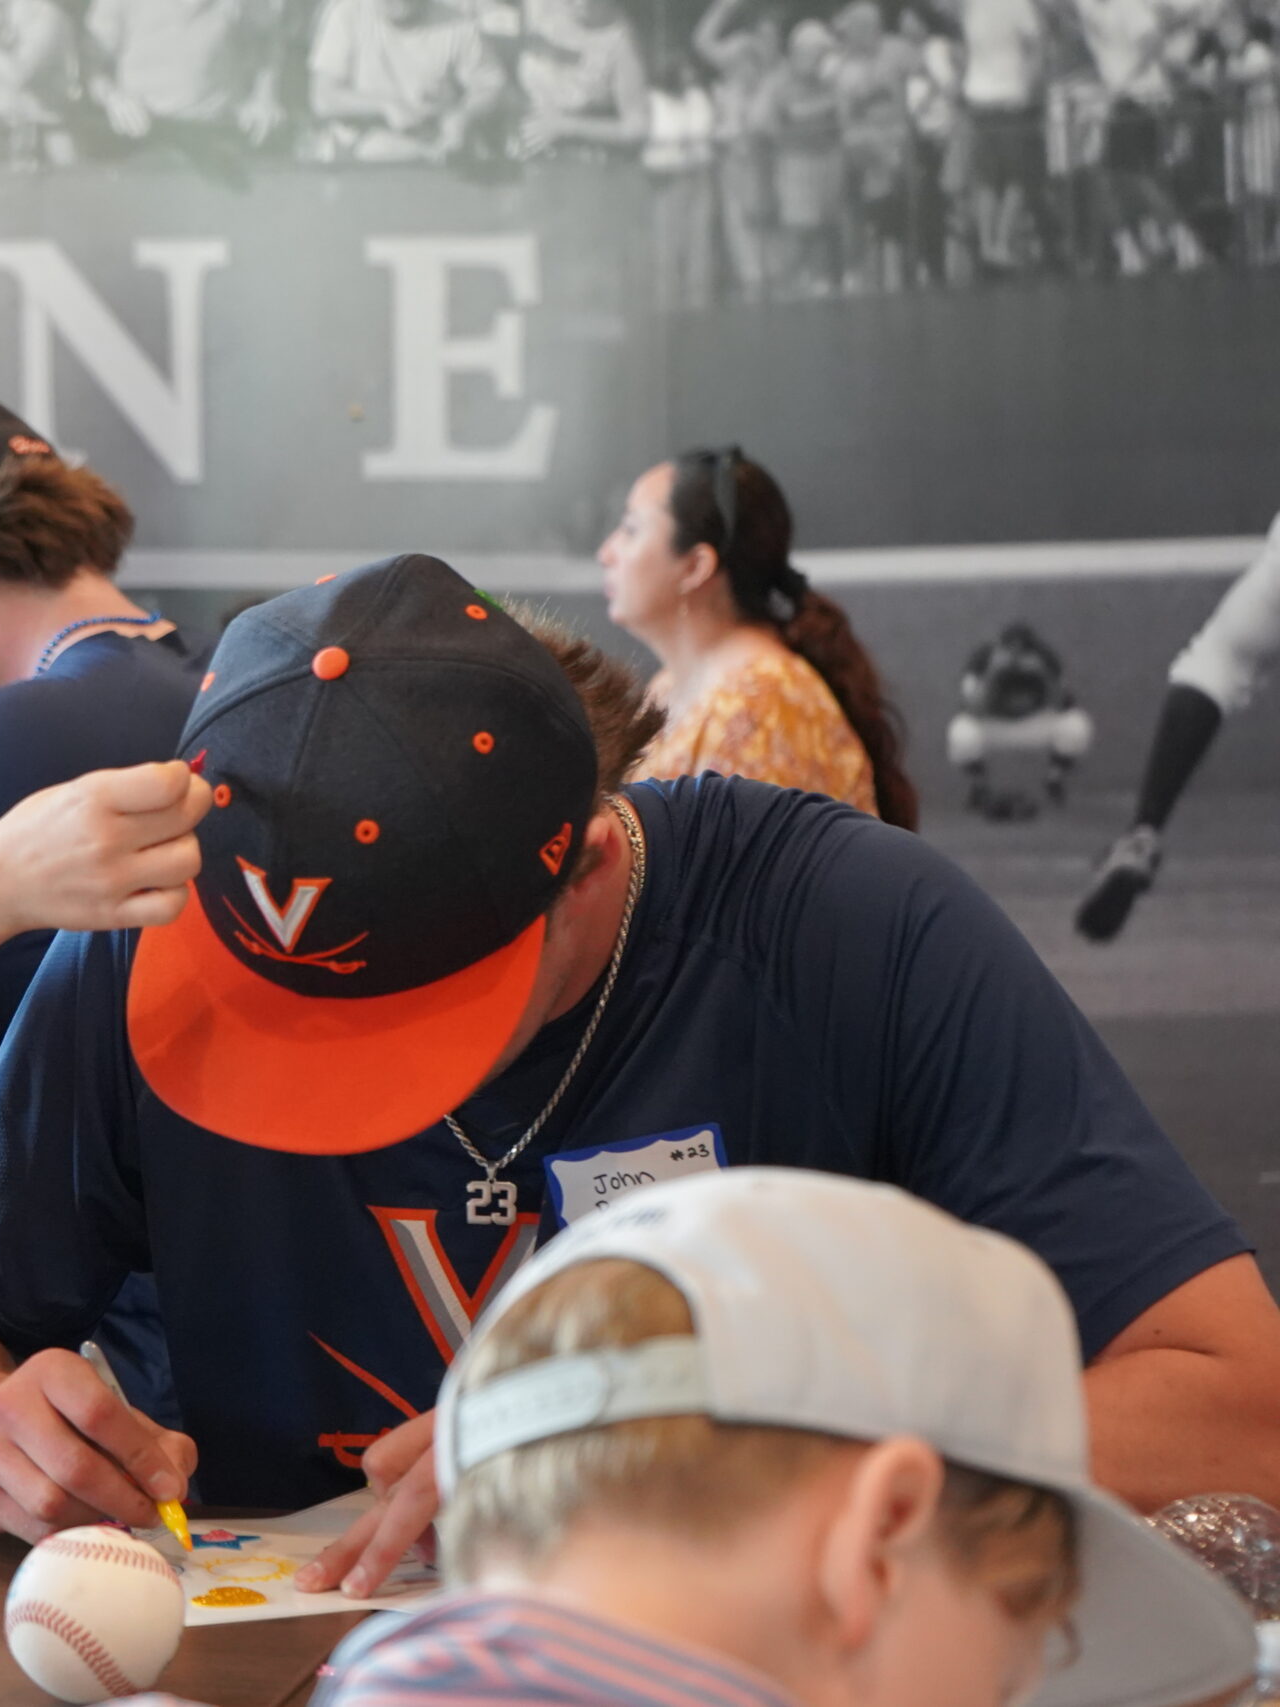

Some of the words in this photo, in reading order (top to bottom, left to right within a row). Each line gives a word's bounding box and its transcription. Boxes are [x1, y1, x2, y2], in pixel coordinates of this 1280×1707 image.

[670, 1143, 710, 1162] #23
[593, 1171, 656, 1195] John
[466, 1180, 518, 1226] 23
